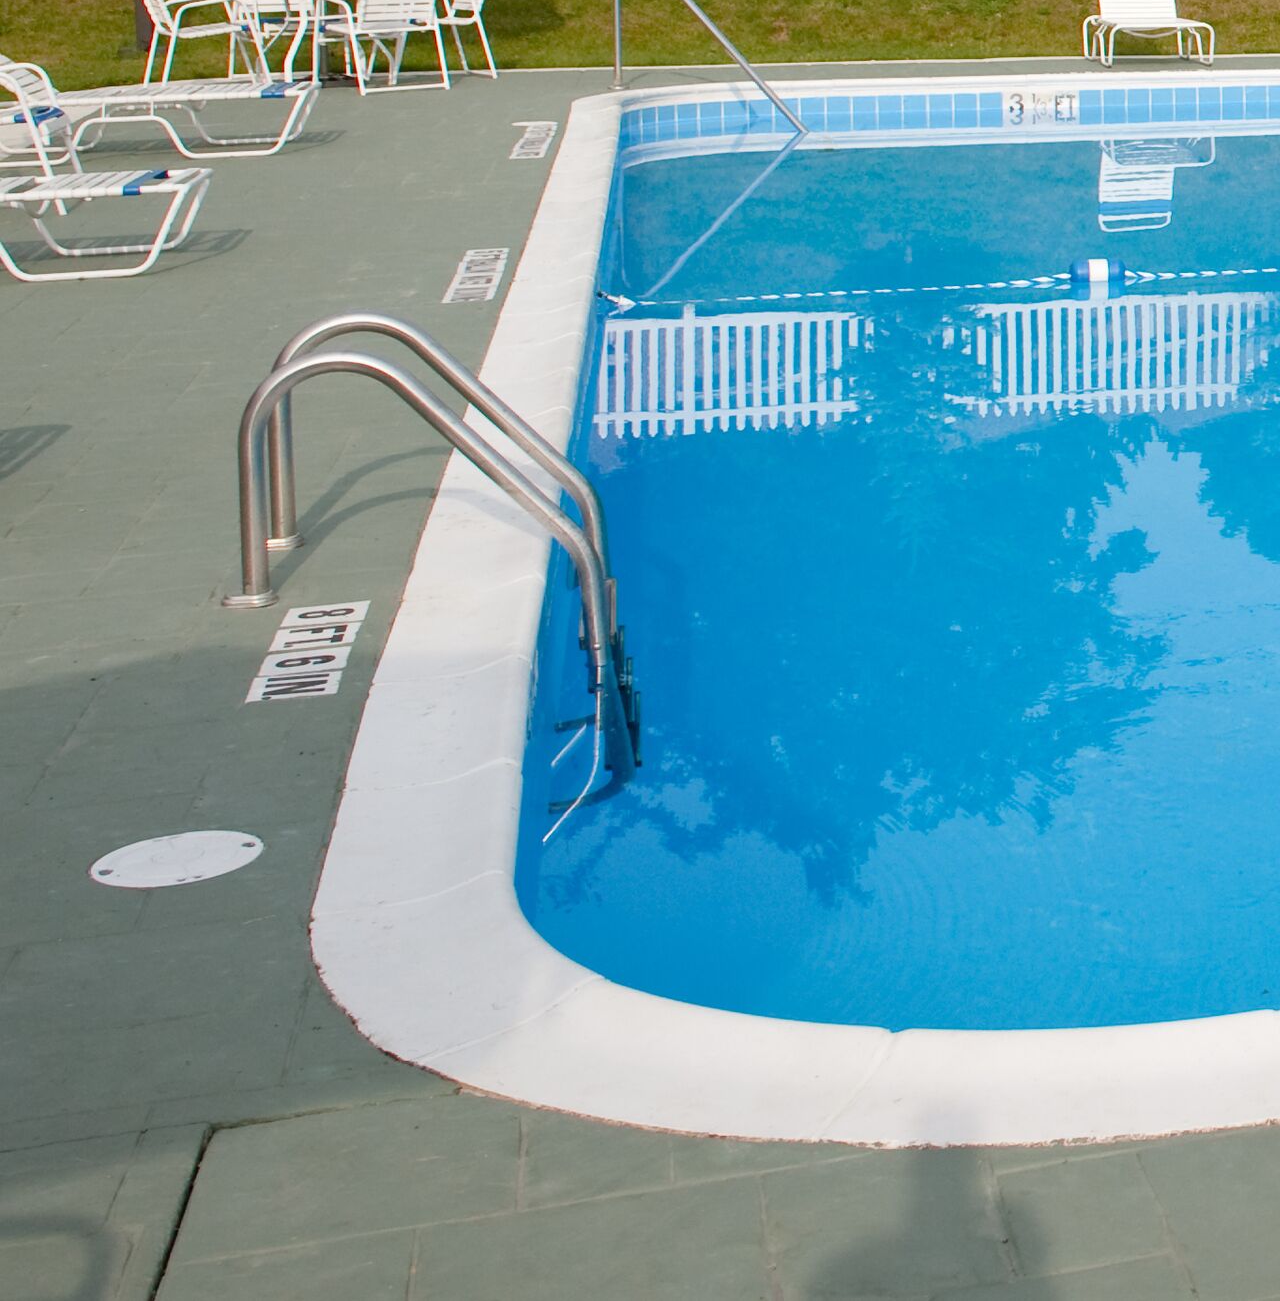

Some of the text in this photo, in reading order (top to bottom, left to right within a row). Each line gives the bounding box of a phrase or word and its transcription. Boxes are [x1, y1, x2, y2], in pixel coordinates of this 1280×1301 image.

[262, 607, 355, 701] 8 FT. 6 IN.
